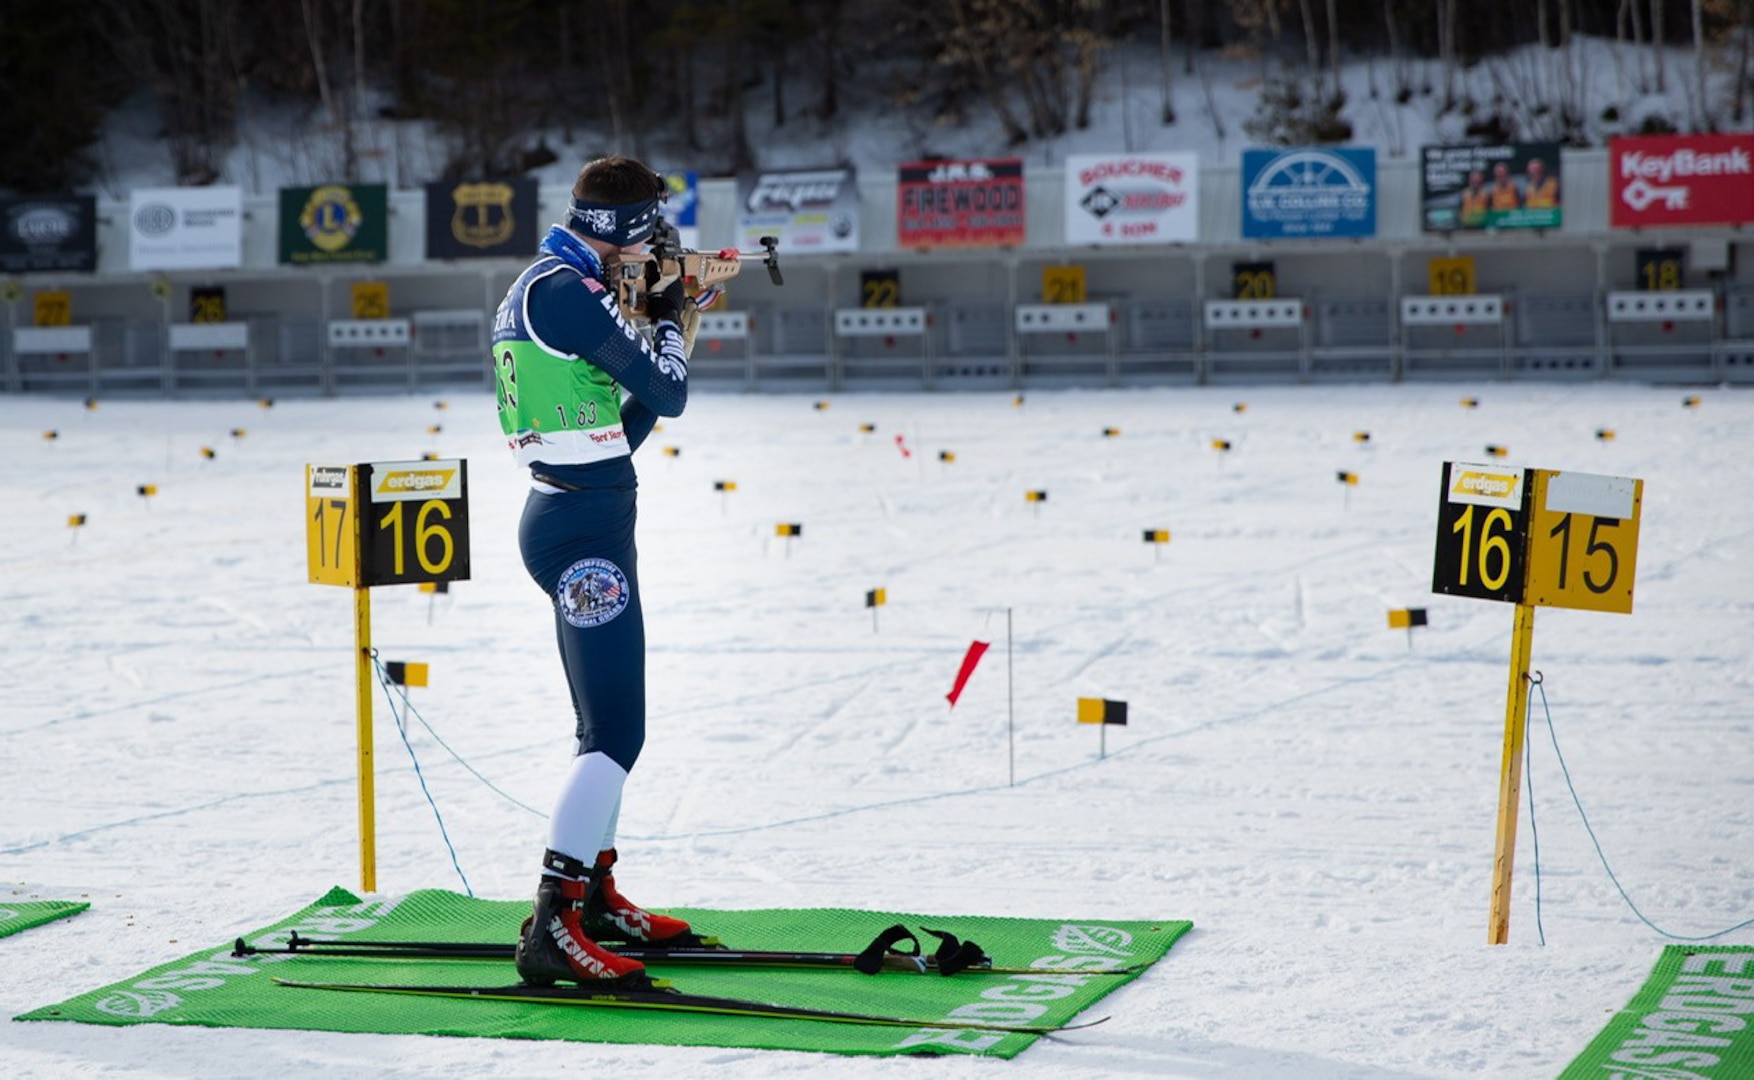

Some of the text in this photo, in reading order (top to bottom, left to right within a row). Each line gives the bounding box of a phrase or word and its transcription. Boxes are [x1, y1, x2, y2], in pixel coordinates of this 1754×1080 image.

[1079, 157, 1184, 187] BOUCHER
[1621, 147, 1750, 182] KeyBank
[903, 184, 1020, 216] FIREWOOD
[323, 205, 336, 228] L
[1237, 271, 1274, 300] 20
[1436, 268, 1468, 296] 19
[1643, 259, 1680, 291] 18
[864, 279, 898, 309] 22
[1049, 277, 1079, 304] 21
[577, 401, 597, 426] 63
[388, 473, 444, 491] erdgas
[1462, 476, 1509, 495] erdgas
[314, 498, 346, 569] 17
[380, 499, 454, 575] 16
[1453, 504, 1513, 591] 16
[1550, 512, 1619, 594] 15
